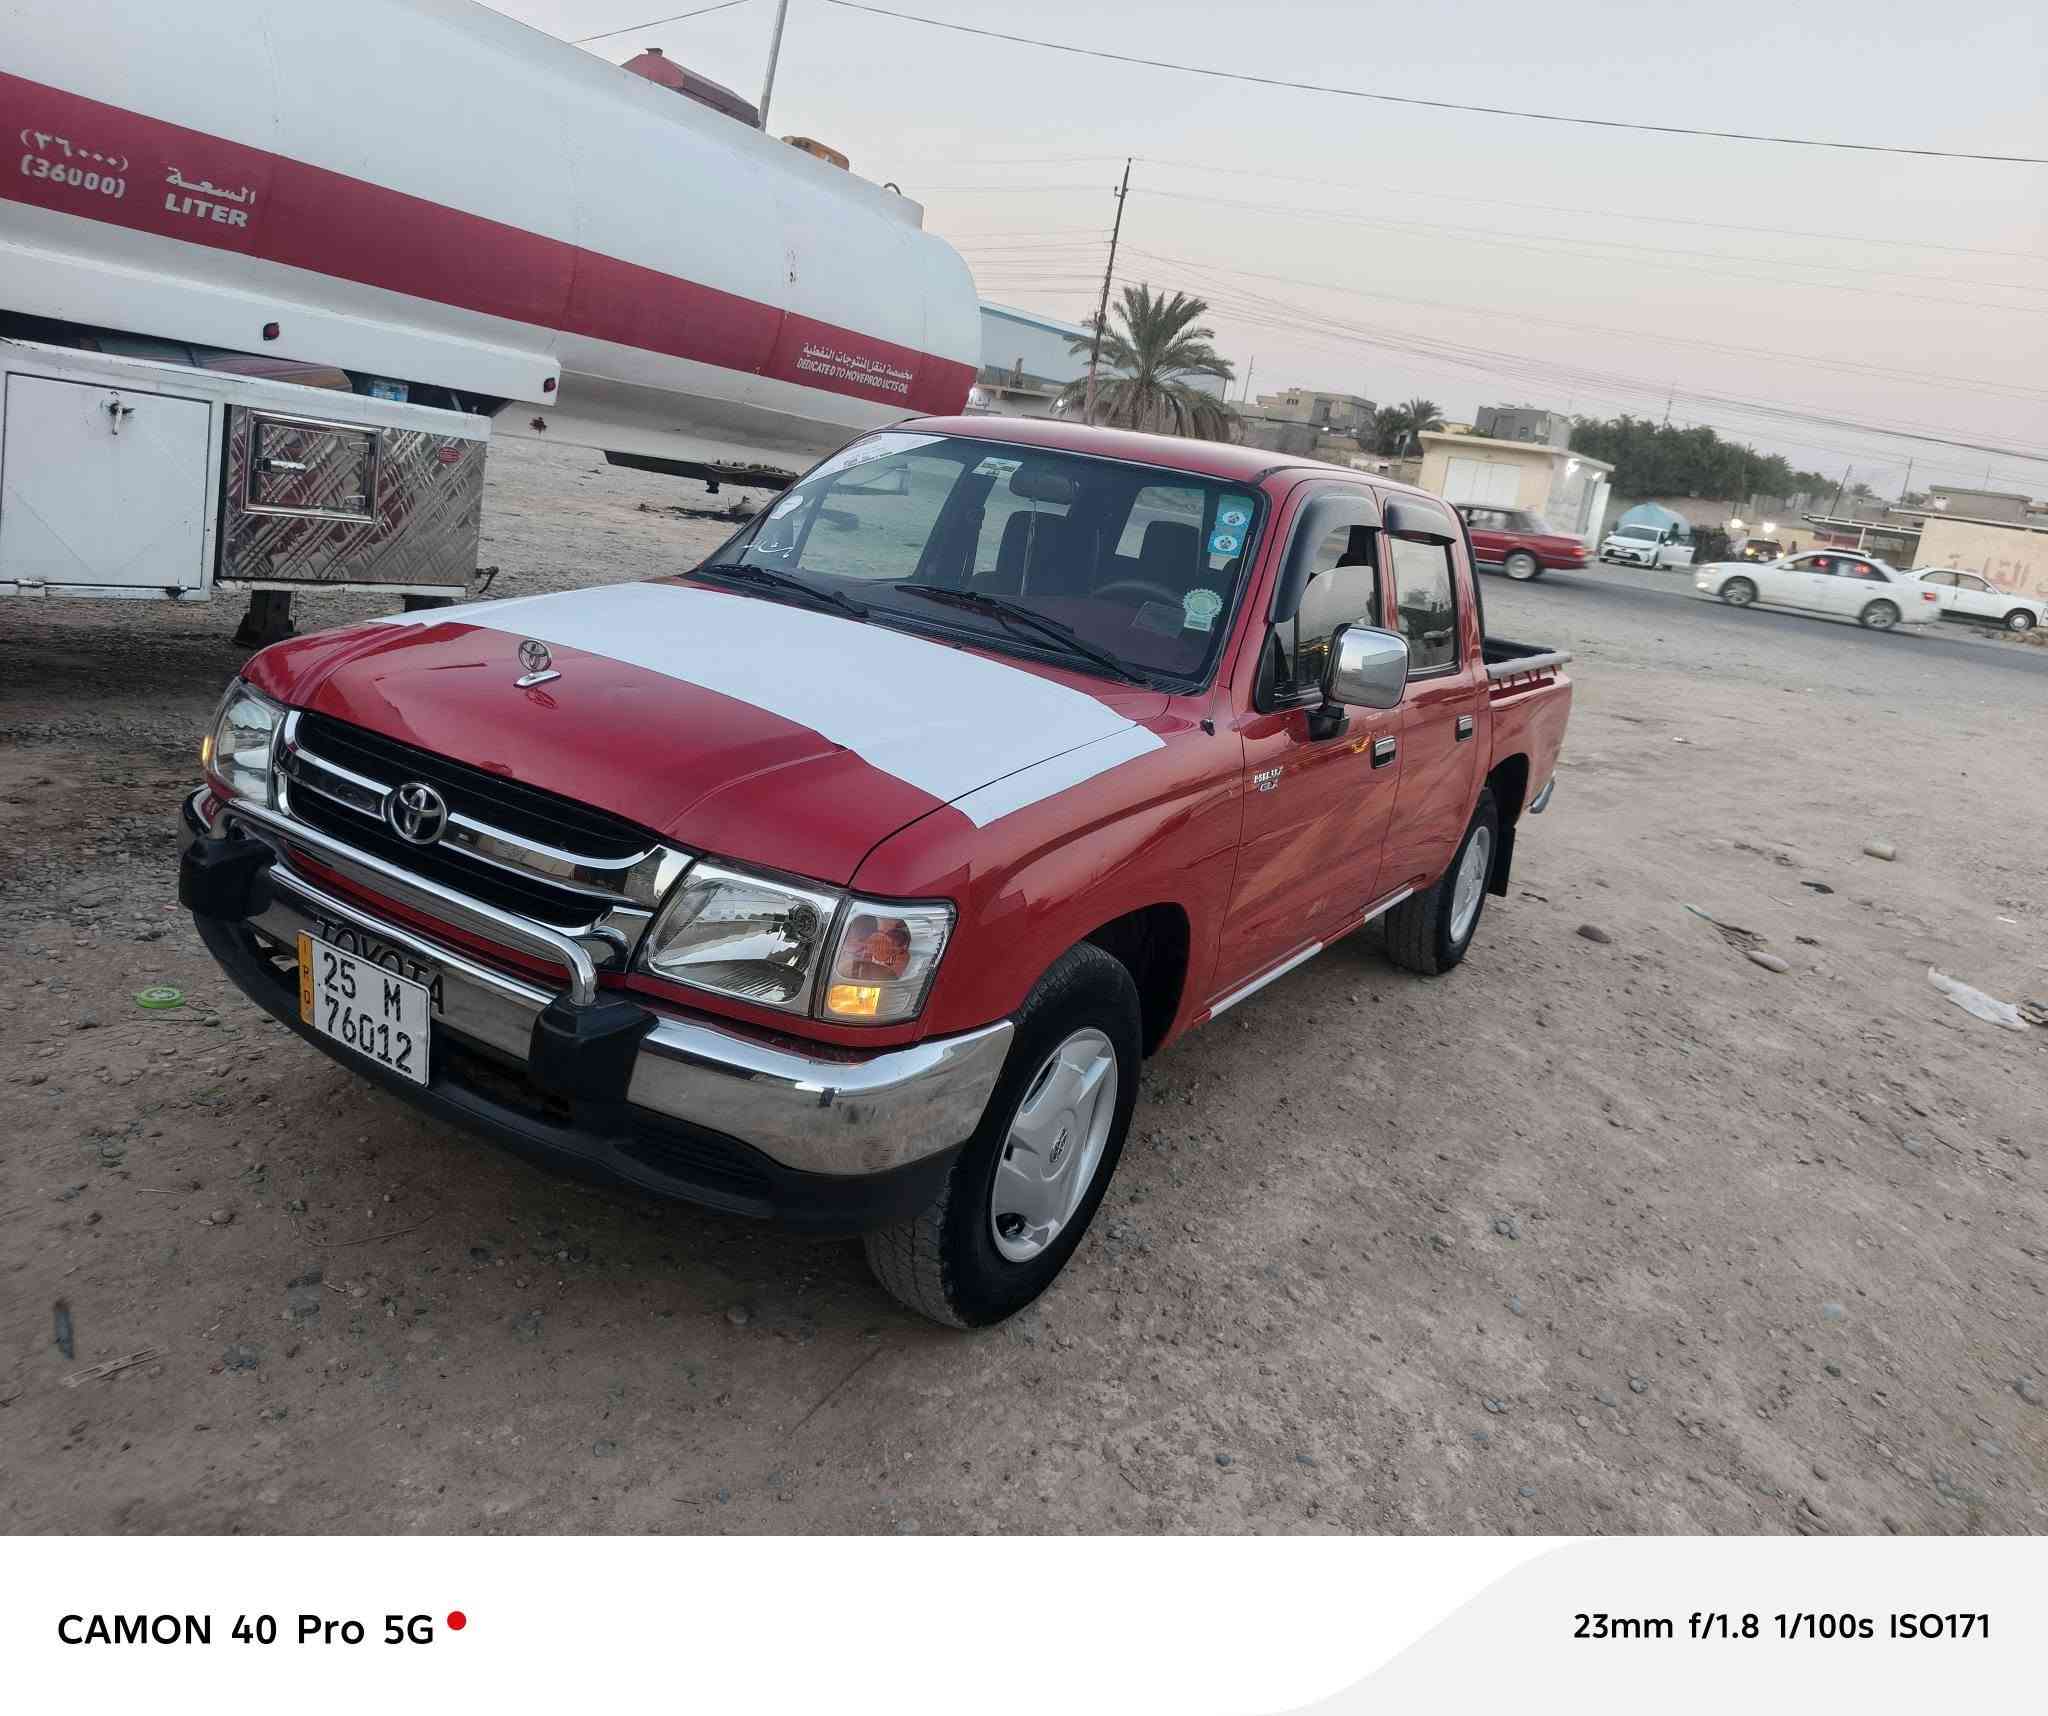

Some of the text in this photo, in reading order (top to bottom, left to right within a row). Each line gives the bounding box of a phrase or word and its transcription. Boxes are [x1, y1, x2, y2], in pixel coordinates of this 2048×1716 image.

[21, 154, 248, 227] (36000) LITER
[166, 166, 256, 204] السعة
[323, 951, 402, 1022] 25 M
[325, 994, 413, 1074] 76012
